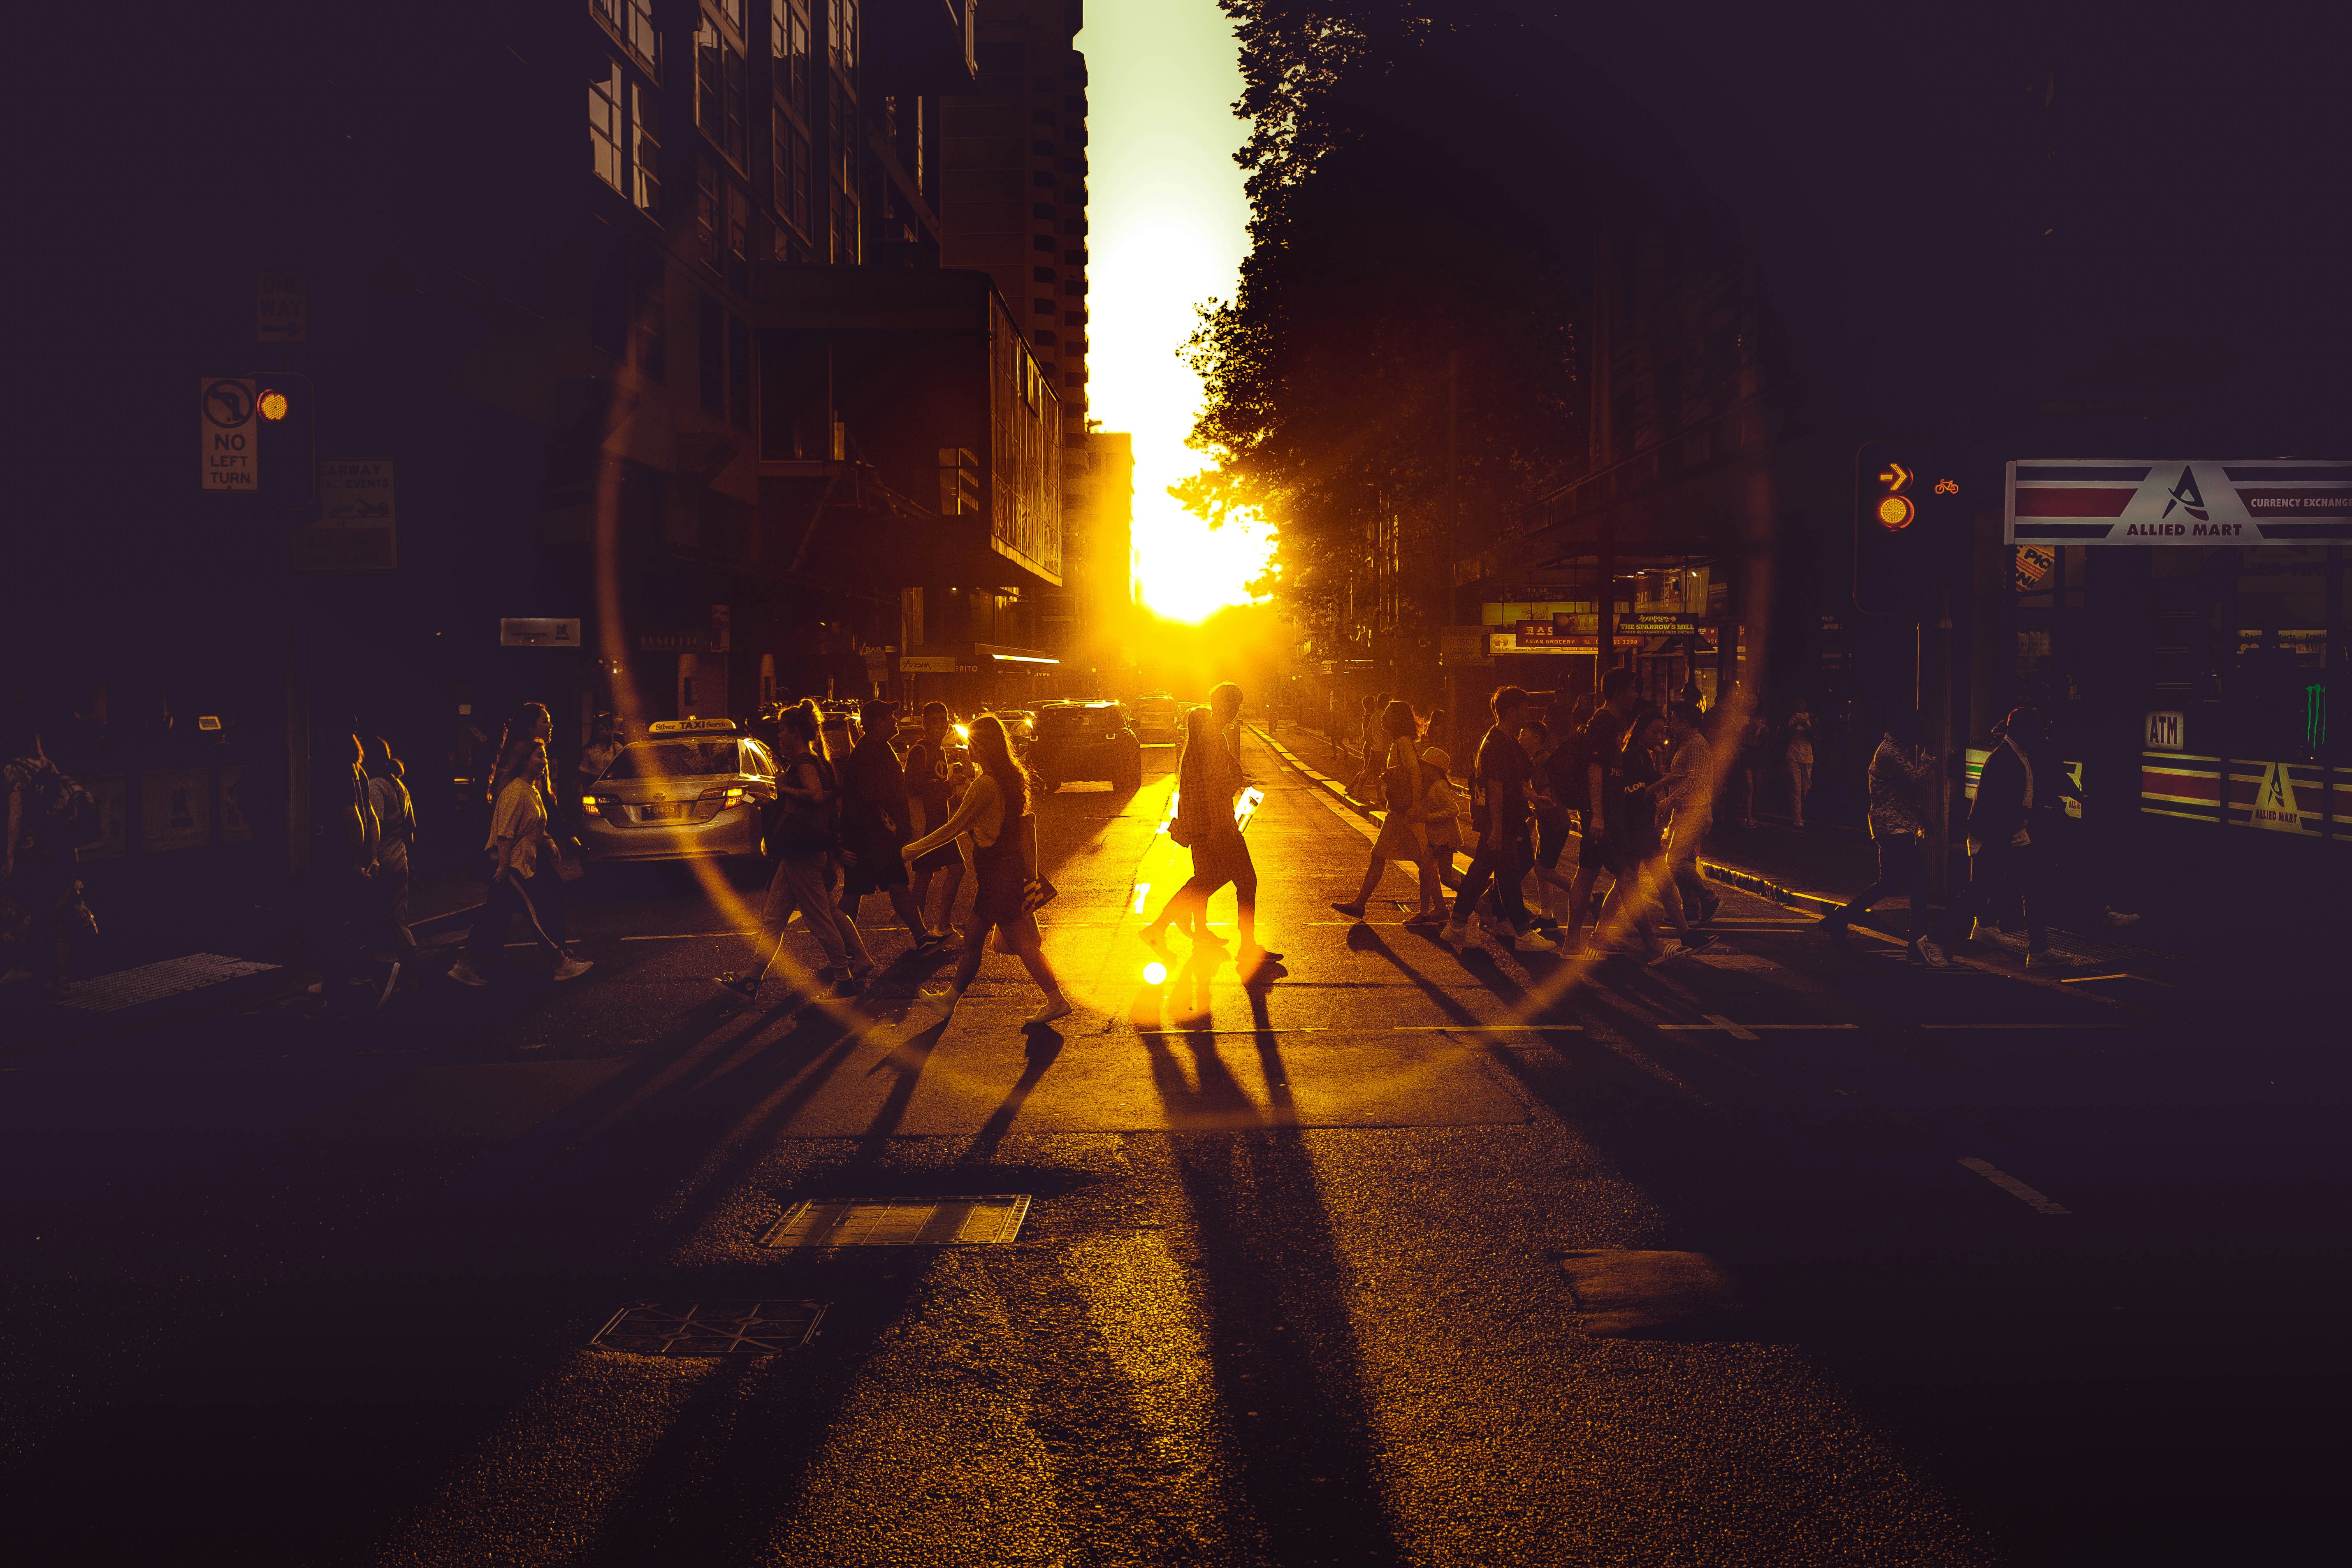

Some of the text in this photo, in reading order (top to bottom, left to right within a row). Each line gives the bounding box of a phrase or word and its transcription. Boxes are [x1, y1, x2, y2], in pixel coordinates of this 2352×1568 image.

[263, 276, 299, 293] ONE
[260, 299, 303, 316] WAY
[215, 433, 246, 451] NO
[211, 455, 248, 467] LEFT
[319, 464, 381, 476] EARWAY
[210, 472, 250, 484] TURN
[346, 479, 390, 489] EVENTS
[2251, 498, 2352, 507] CURRENCY EXCHANGE
[2126, 524, 2242, 536] ALLIED MART
[680, 721, 705, 729] TAXI
[2149, 715, 2178, 745] ATM
[2255, 809, 2297, 824] ALLIED MART
